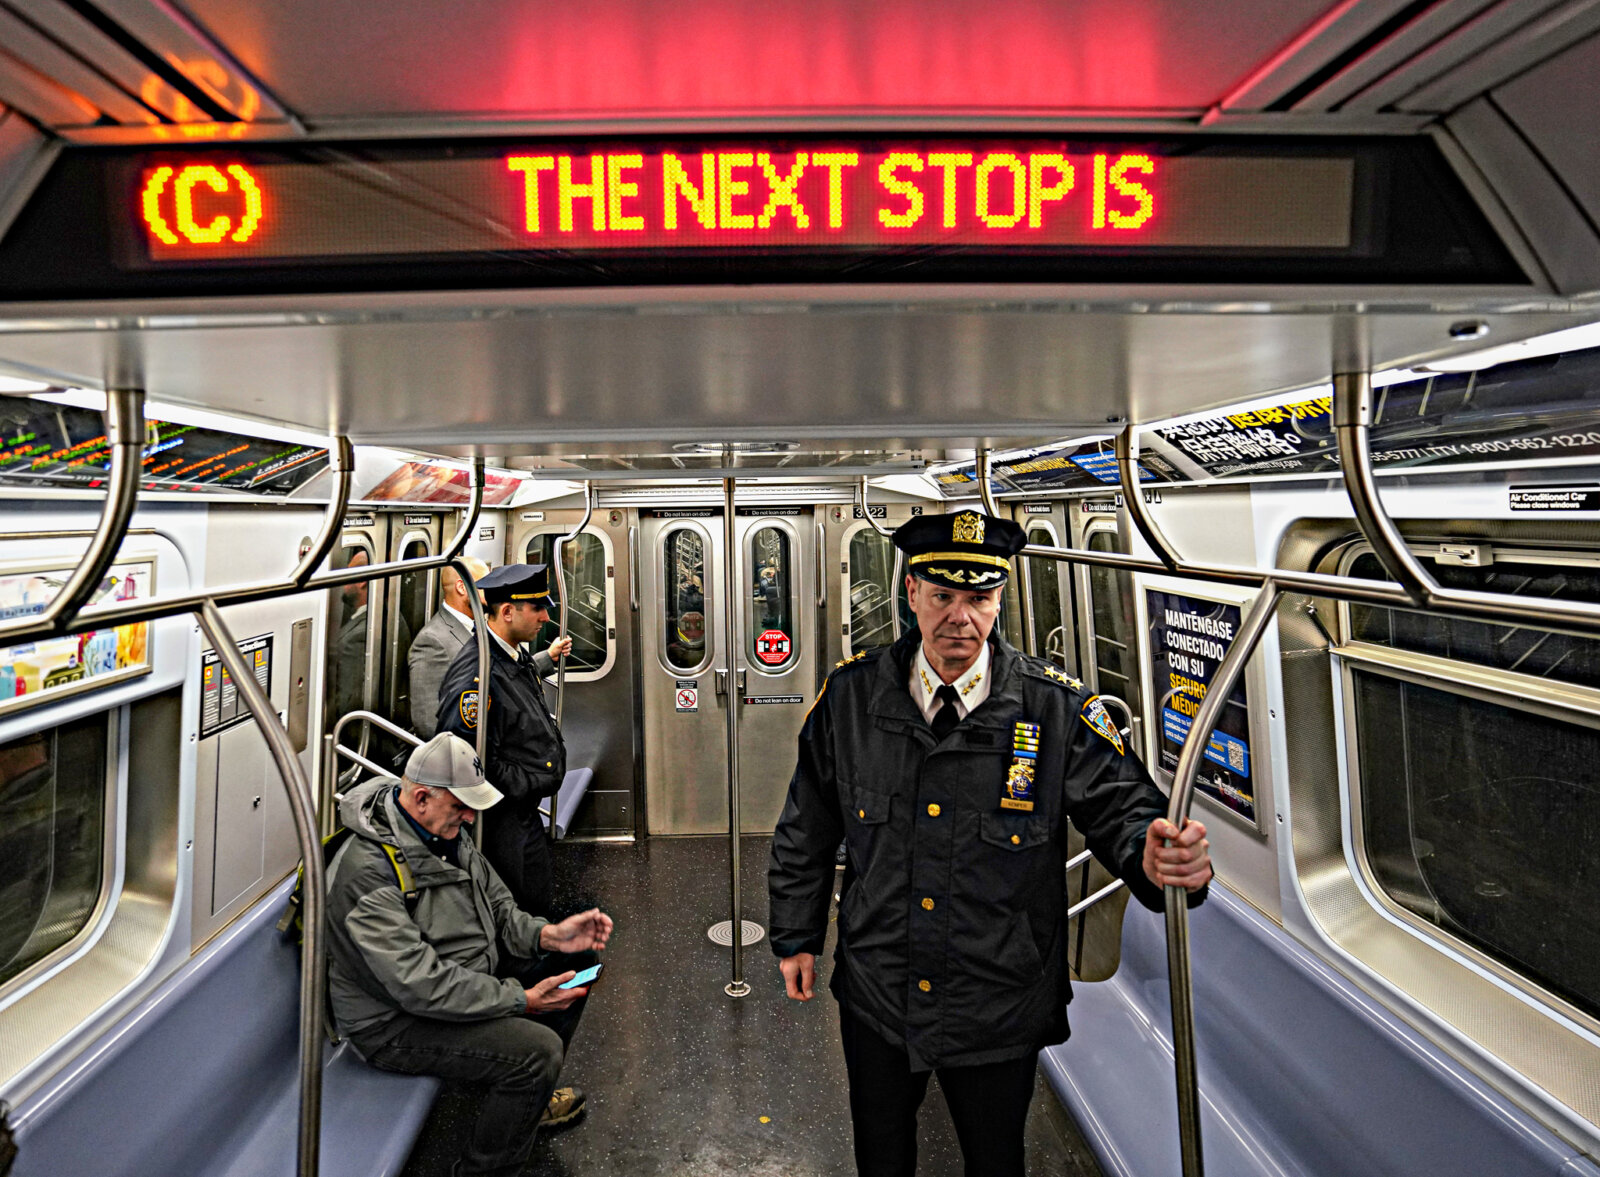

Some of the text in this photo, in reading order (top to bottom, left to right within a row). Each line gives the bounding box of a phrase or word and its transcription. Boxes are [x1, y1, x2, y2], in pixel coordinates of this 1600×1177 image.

[143, 152, 1154, 244] (C) THE NEXT STOP IS
[1426, 445, 1460, 456] TTY
[1461, 432, 1600, 454] 1-800-662-1220
[1510, 492, 1587, 502] Air Conditioned Car
[856, 507, 884, 517] 322
[1165, 609, 1232, 641] MANTÉNGASE
[1166, 630, 1224, 661] CONECTADO
[1169, 652, 1204, 677] CON SU
[1170, 673, 1207, 700] SEGURO
[1171, 693, 1200, 718] MÉDIC
